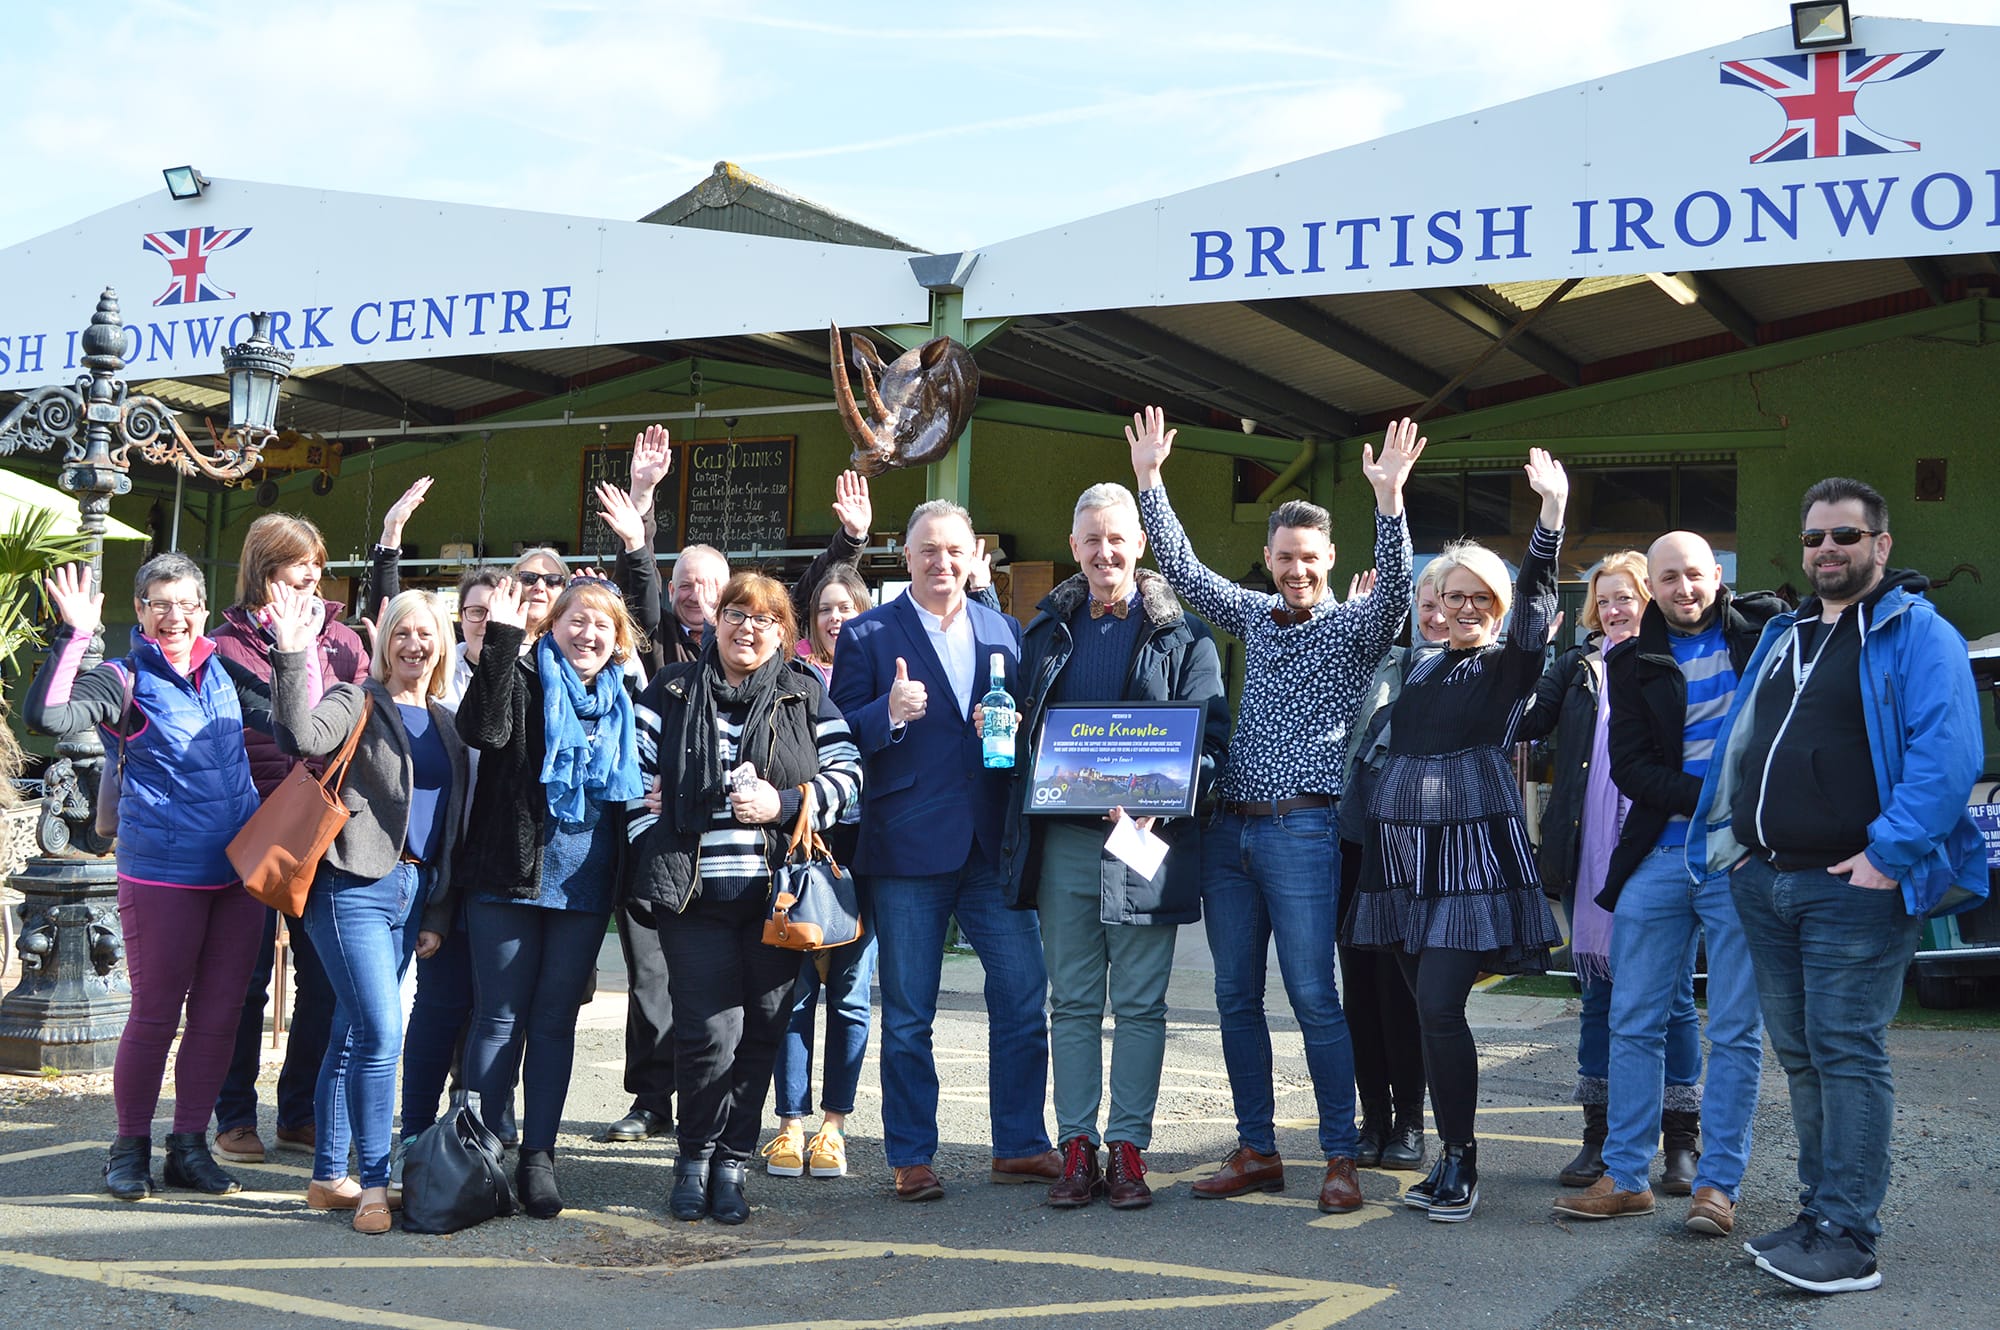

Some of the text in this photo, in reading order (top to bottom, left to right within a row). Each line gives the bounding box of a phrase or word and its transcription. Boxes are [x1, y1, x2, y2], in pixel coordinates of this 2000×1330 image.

[1188, 169, 2000, 282] BRITISH IRONWO
[63, 306, 334, 370] IONWORK
[350, 285, 572, 345] CENTRE
[731, 443, 783, 468] DRINKS
[1071, 722, 1168, 737] Clive Knowles
[1036, 787, 1062, 805] go
